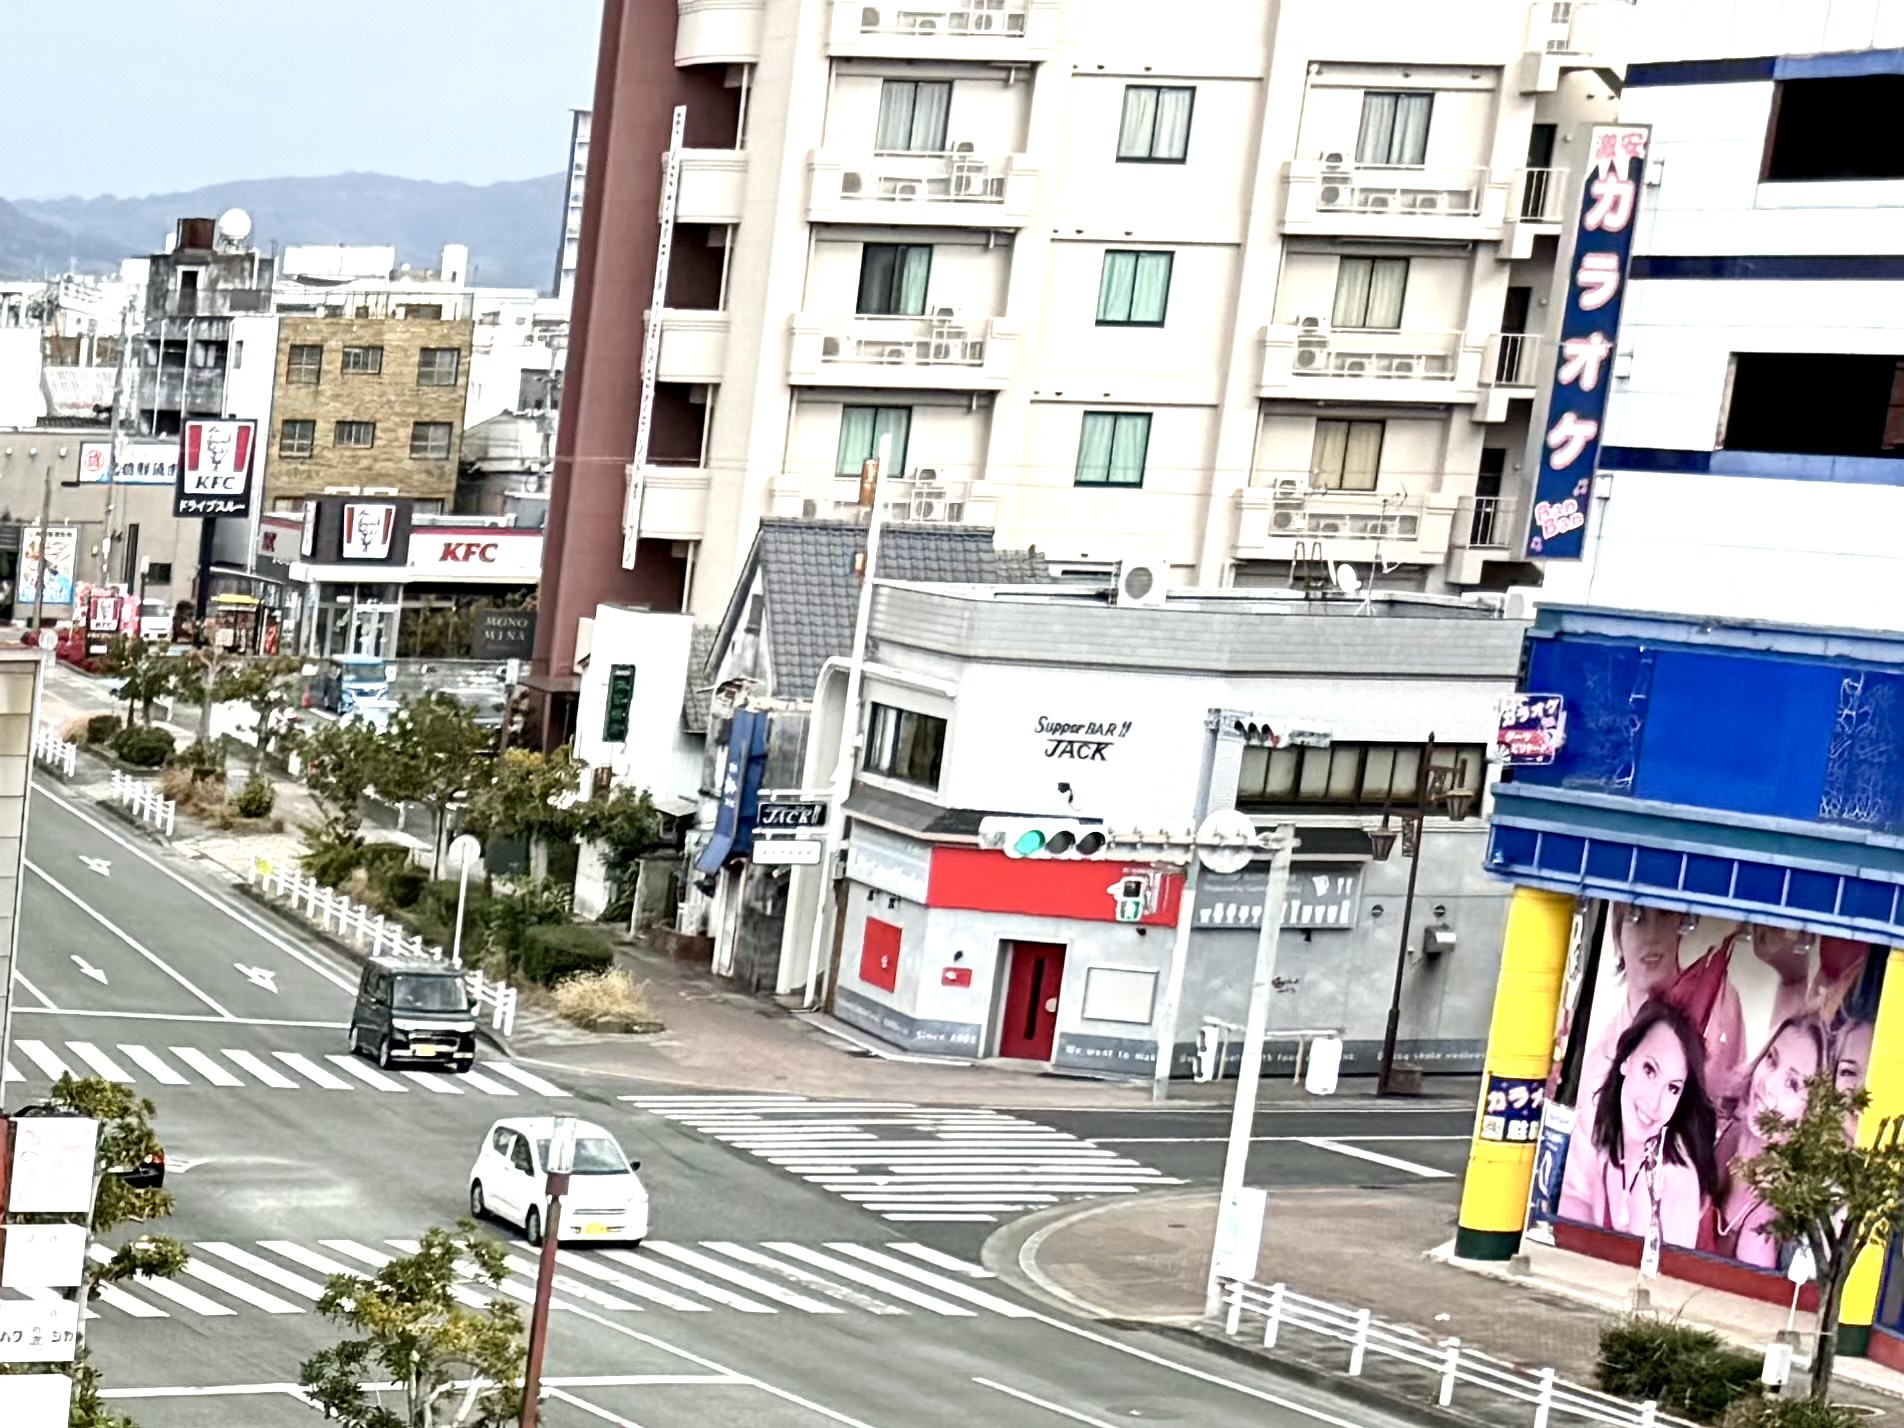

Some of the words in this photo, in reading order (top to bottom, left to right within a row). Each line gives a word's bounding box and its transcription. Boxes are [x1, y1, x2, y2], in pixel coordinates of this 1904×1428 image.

[1547, 172, 1634, 470] カラオケ
[195, 476, 235, 490] KFC
[179, 500, 245, 513] ドライブスルー
[439, 543, 499, 562] KFC
[1044, 738, 1115, 761] JACK
[763, 806, 812, 824] JACK
